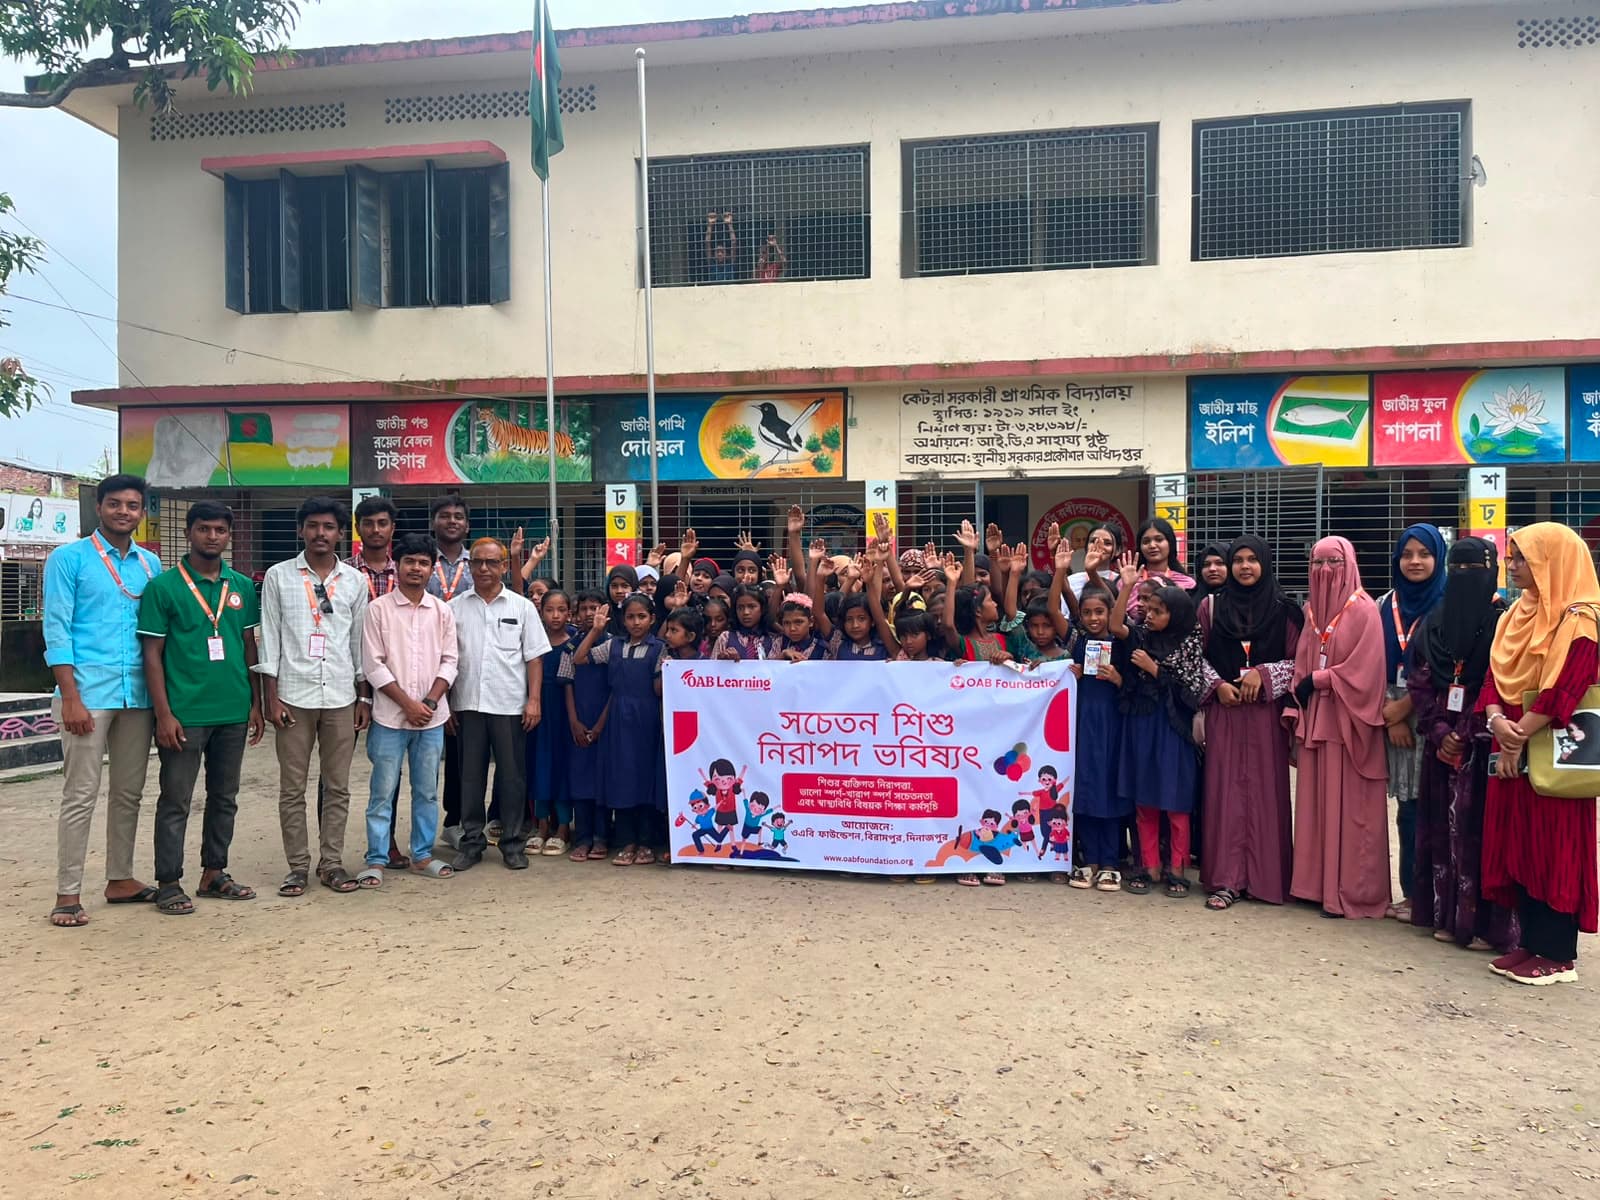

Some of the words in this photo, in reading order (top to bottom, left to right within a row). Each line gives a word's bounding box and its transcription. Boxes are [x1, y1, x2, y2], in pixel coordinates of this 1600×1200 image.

[948, 386, 996, 404] সরকারী
[1001, 384, 1060, 402] প্রাথমিক
[1066, 383, 1133, 401] বিদ্যালয়
[983, 408, 1024, 418] ১৯১৯
[1029, 405, 1058, 416] সাল
[1199, 399, 1234, 415] জাতীয়
[1236, 400, 1258, 416] মাছ
[1382, 394, 1419, 411] জাতীয়
[1422, 397, 1448, 414] ফুল
[376, 415, 407, 430] জাতীয়
[411, 416, 428, 429] পশু
[620, 416, 651, 432] জাতী
[658, 414, 685, 431] পাখি
[1204, 419, 1255, 445] ইলিশ
[1382, 421, 1442, 442] শাপলা
[373, 436, 402, 448] রয়েল
[374, 450, 427, 470] টাইগার
[972, 448, 1006, 467] স্থানীয়
[1087, 446, 1143, 461] অধিদপ্তর
[687, 676, 714, 688] OAB
[717, 676, 771, 691] Learning
[966, 678, 992, 688] OAB
[779, 712, 879, 735] সচেতন
[892, 703, 954, 736] শিশু
[757, 732, 861, 766] নিরাপদ
[873, 735, 982, 770] ভবিষ্যৎ
[817, 776, 840, 787] শিশুর
[841, 777, 875, 789] ব্যক্তিগত
[799, 788, 822, 797] ভালো
[894, 792, 933, 801] সচেতনতা
[854, 798, 883, 809] বিষয়ক
[884, 800, 906, 811] শিক্ষা
[908, 800, 939, 813] কর্মসূচি
[791, 827, 815, 838] ওএবি
[824, 855, 914, 867] www.oabfoundation.org
